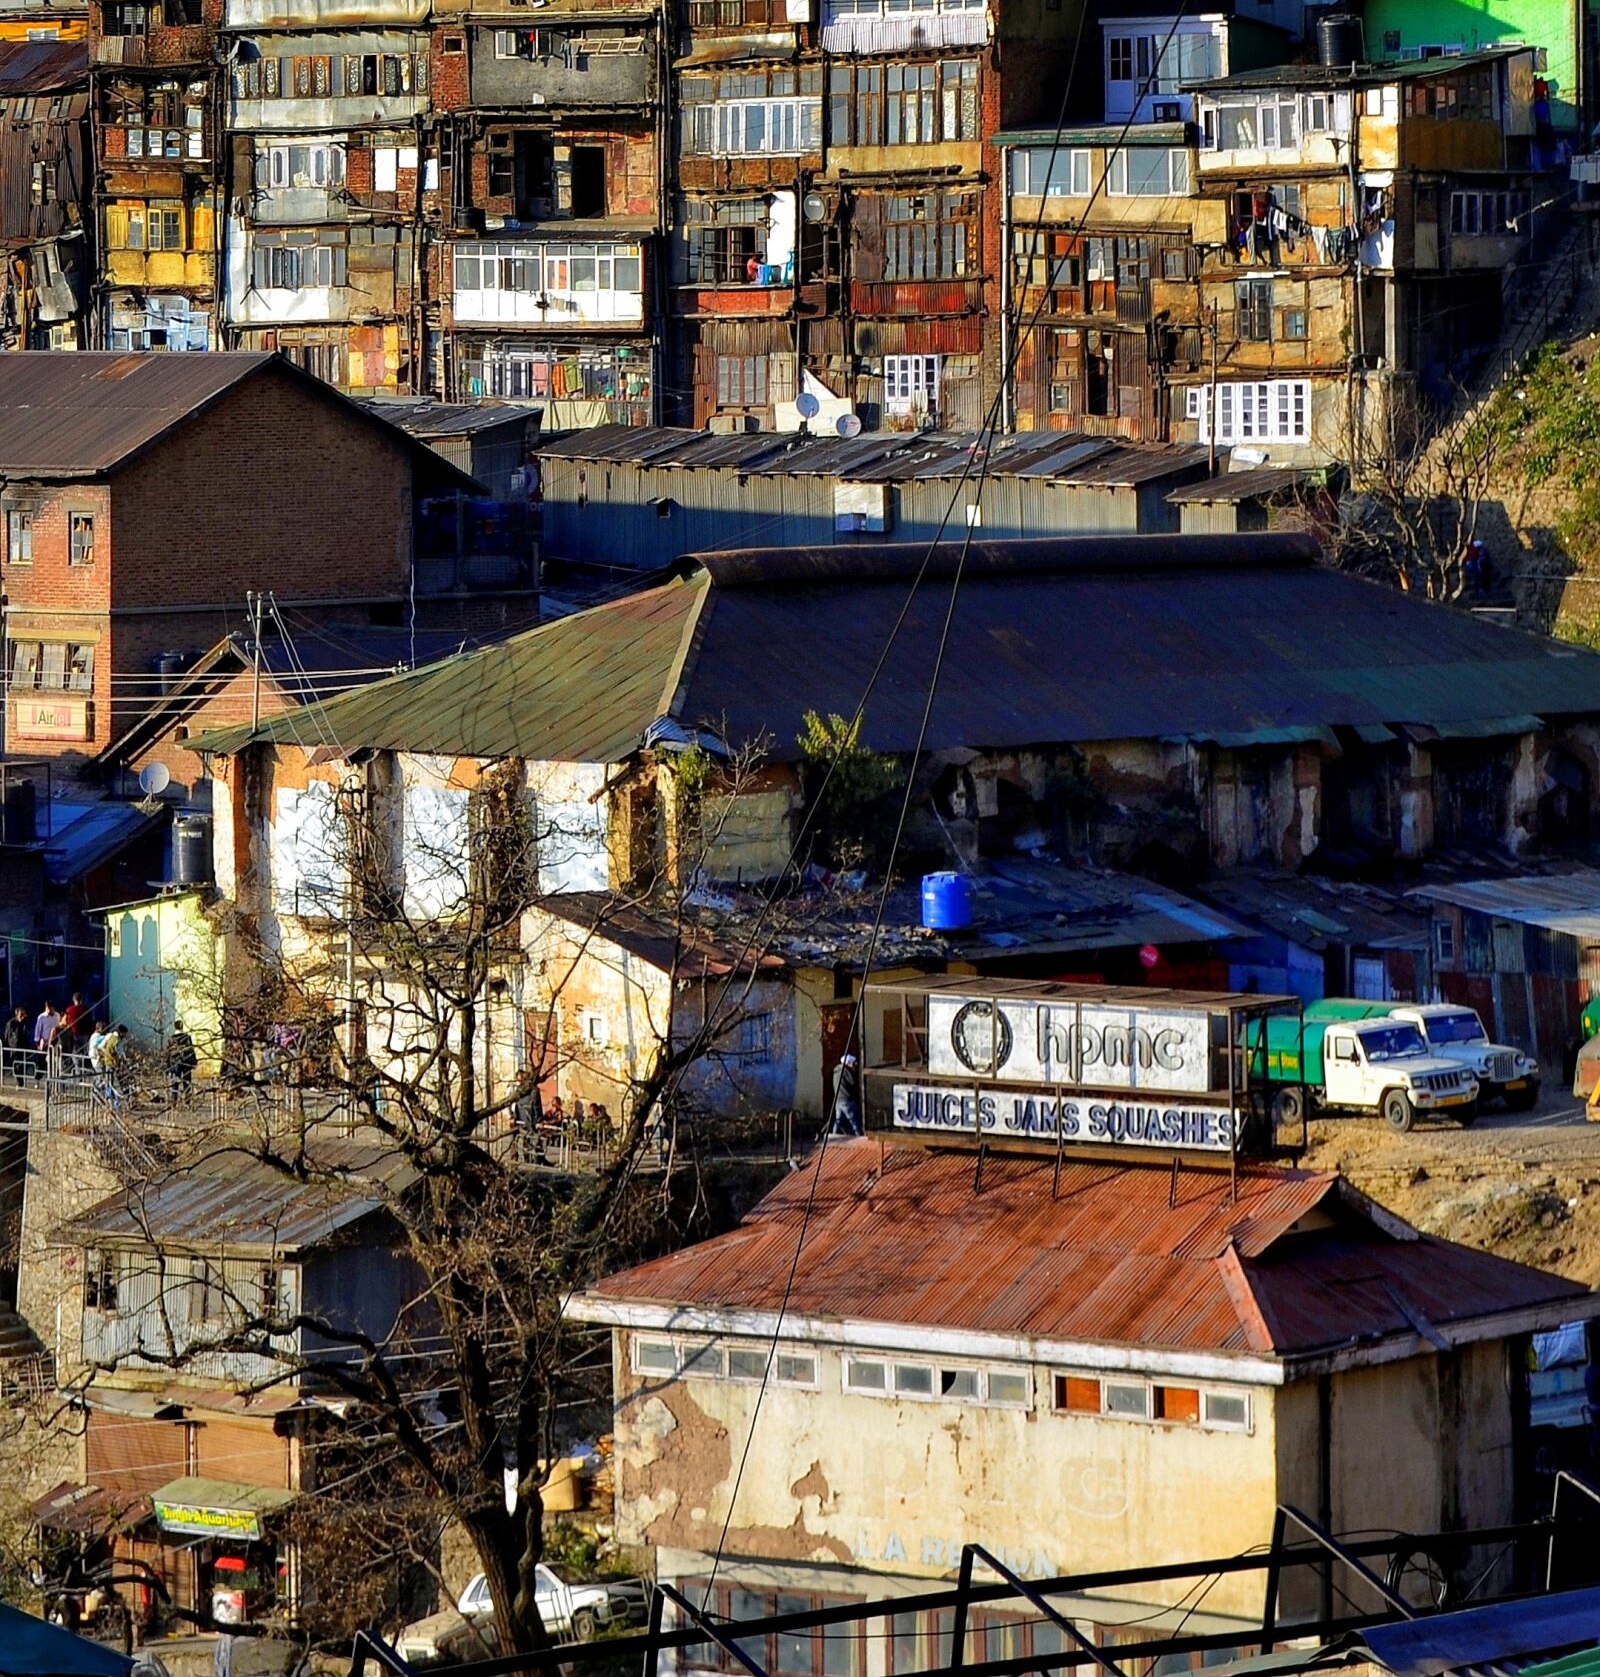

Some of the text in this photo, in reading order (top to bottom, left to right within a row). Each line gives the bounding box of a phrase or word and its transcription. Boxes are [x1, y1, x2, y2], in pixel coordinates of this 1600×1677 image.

[1036, 1004, 1184, 1080] hpmc
[898, 1091, 1232, 1146] JUICES JAMS SQUASHES
[921, 1536, 1060, 1578] REION
